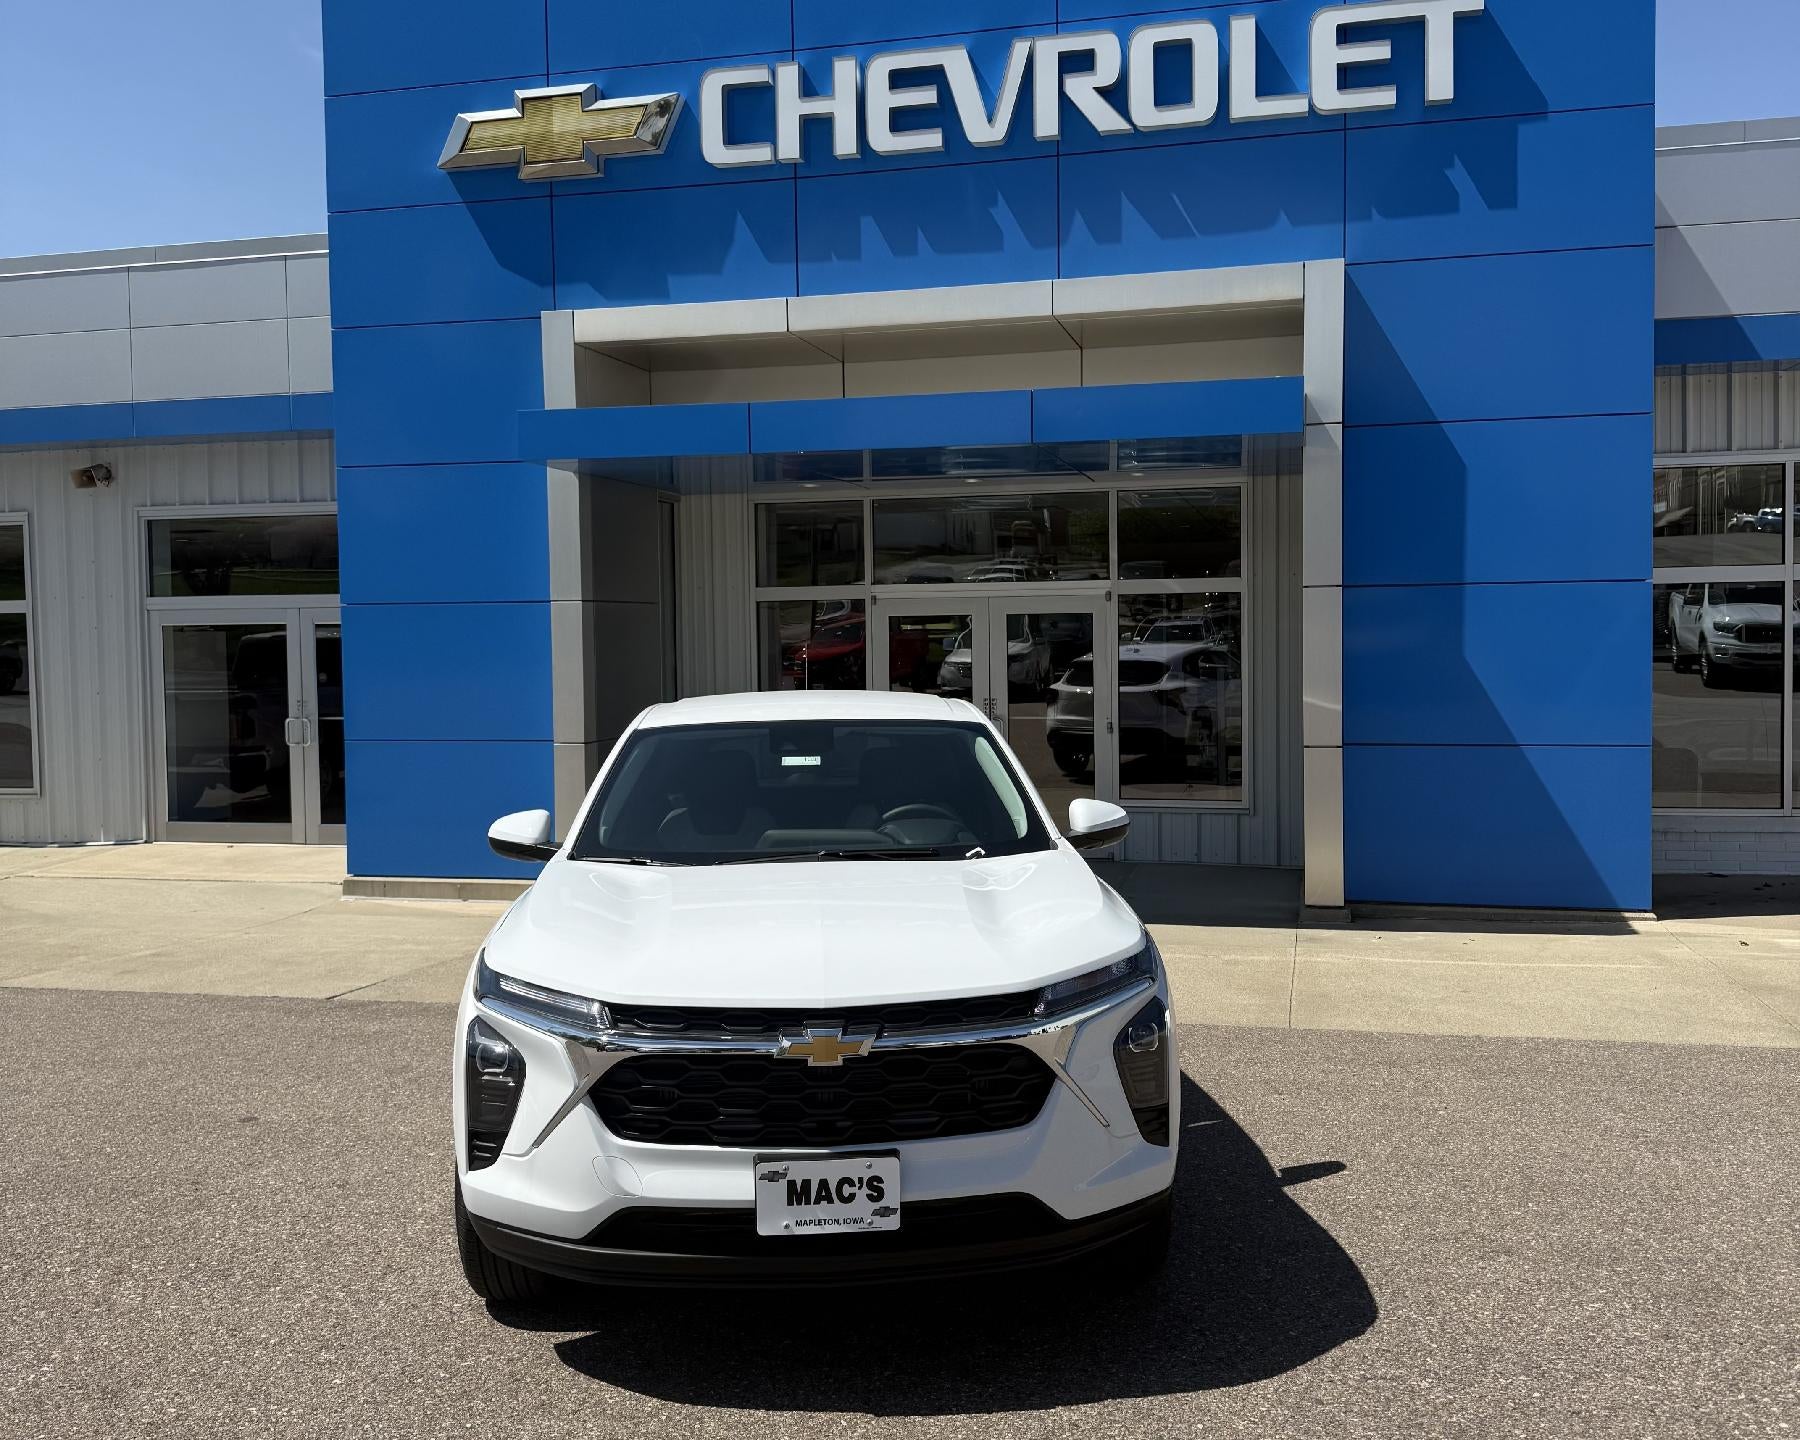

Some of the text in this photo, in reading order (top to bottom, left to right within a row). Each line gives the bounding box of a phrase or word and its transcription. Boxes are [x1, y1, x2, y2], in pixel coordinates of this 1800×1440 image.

[700, 0, 1485, 168] CHEVROLET
[786, 1175, 885, 1206] MAC'S
[795, 1217, 865, 1227] MAPLETON, IOWA
